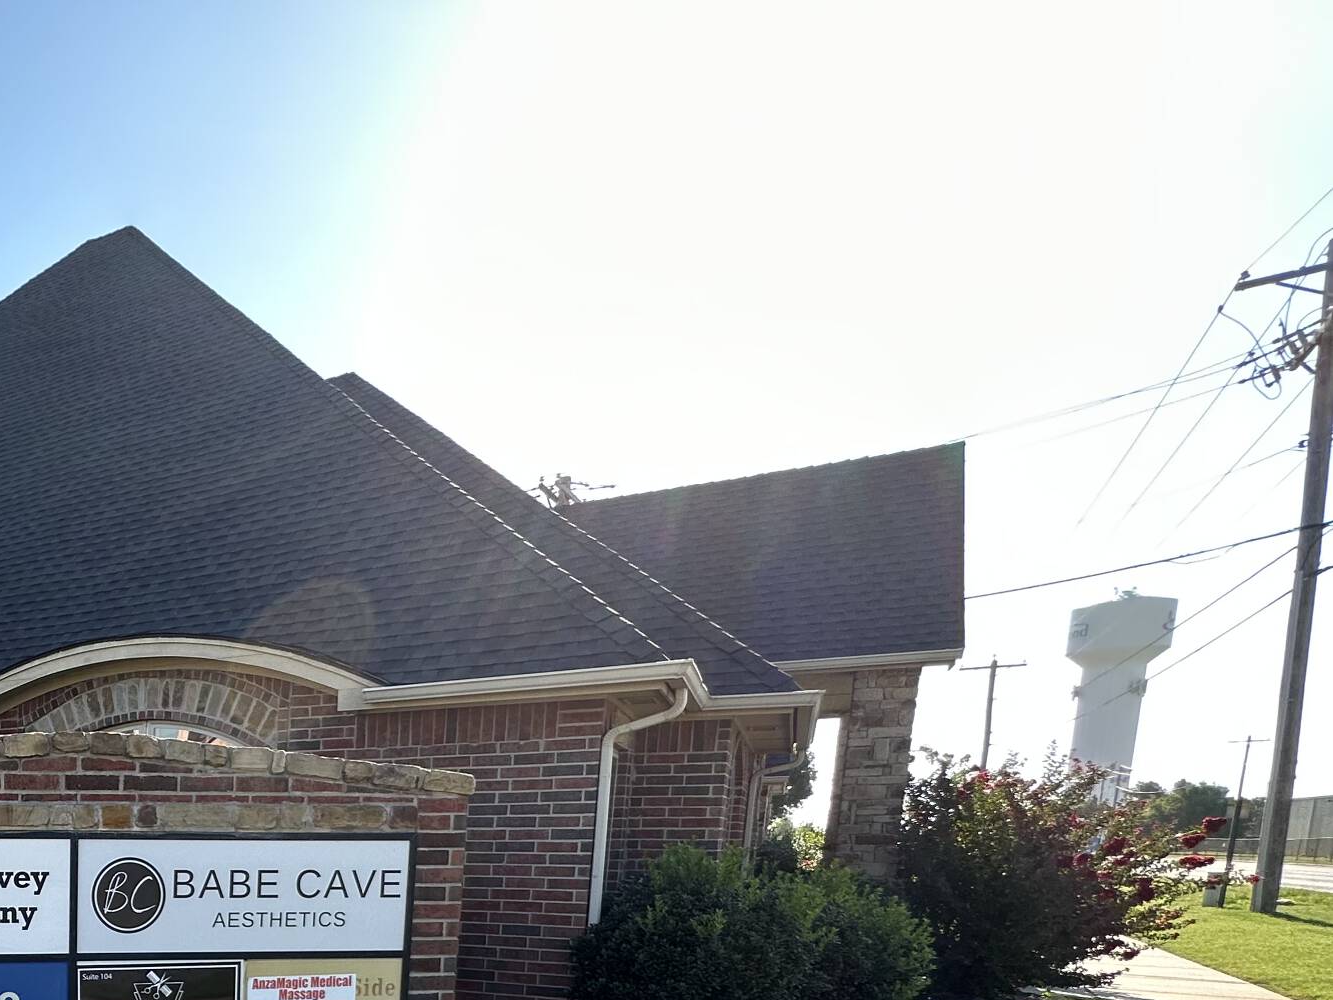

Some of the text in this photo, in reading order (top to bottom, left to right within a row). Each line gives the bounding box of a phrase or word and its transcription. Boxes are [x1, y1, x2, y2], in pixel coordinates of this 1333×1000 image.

[172, 869, 402, 899] BABE CAVE
[103, 871, 157, 914] BC
[212, 911, 346, 928] AESTHETICS
[82, 973, 100, 981] Suite
[252, 975, 352, 990] AnzaMagic Medical
[278, 989, 326, 1000] Massage
